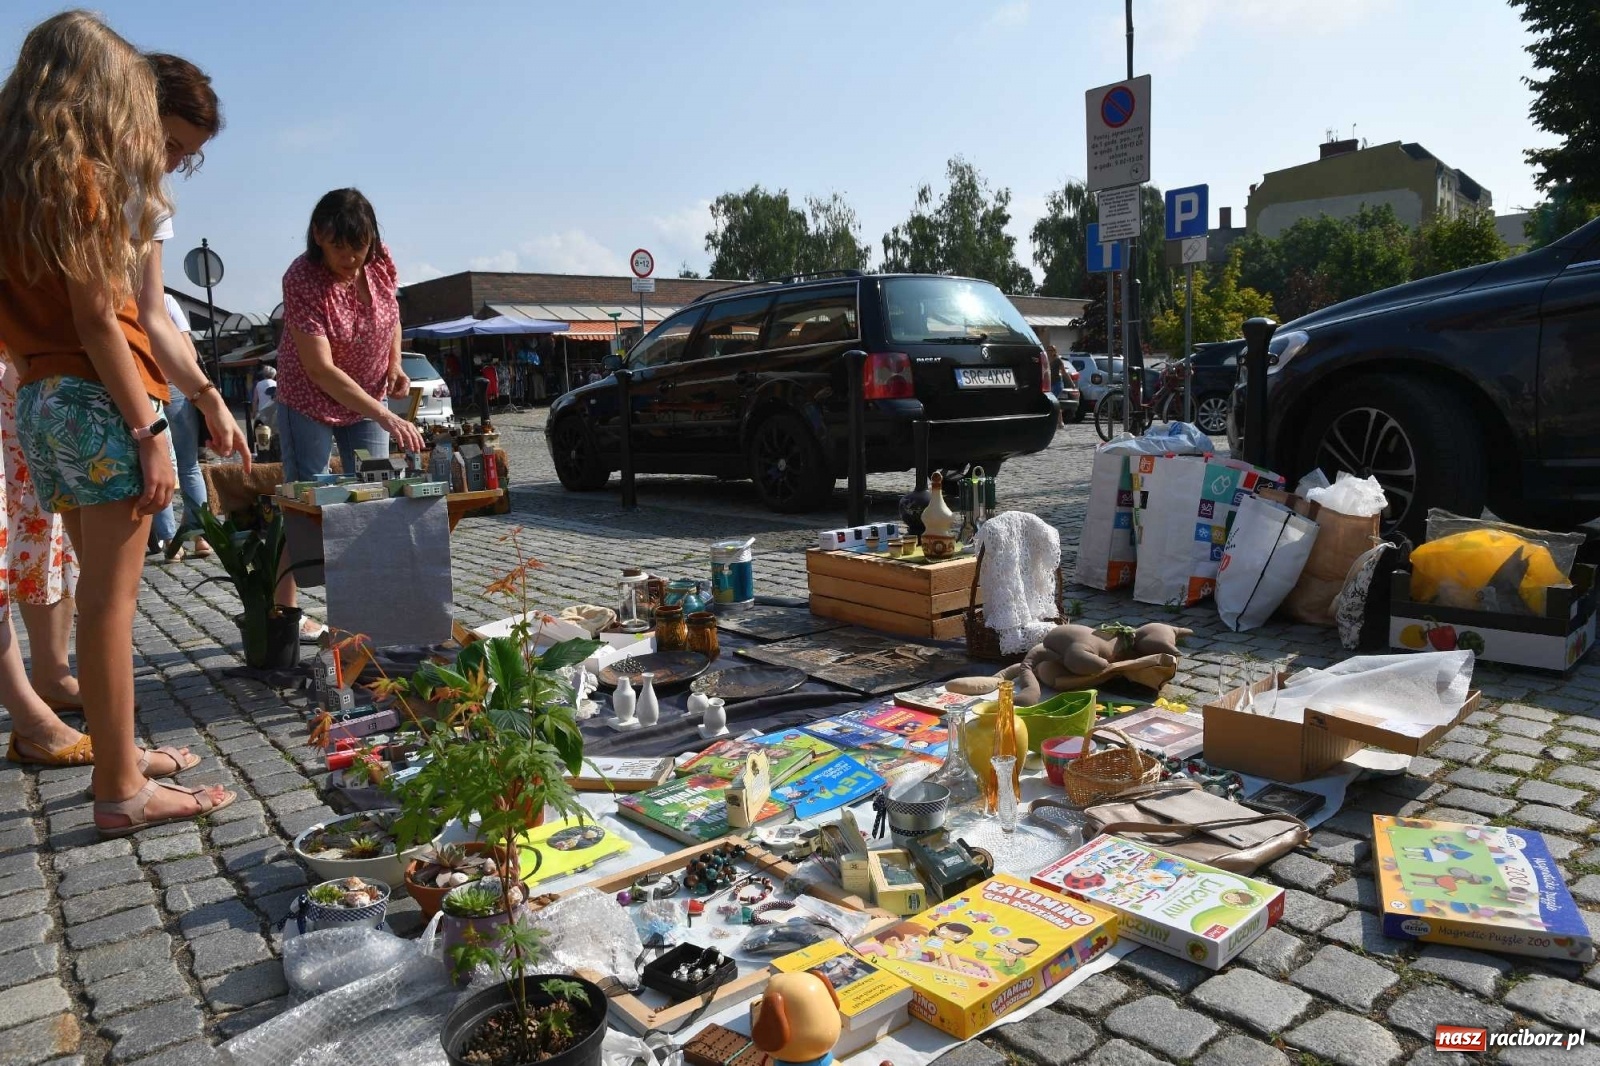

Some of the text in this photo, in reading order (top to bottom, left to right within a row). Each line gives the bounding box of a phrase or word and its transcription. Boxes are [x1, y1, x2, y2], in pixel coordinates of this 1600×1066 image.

[1175, 192, 1199, 233] P
[983, 892, 1073, 929] GRA RODZINNA
[1438, 926, 1550, 948] Magnetic Puzzle ZOO
